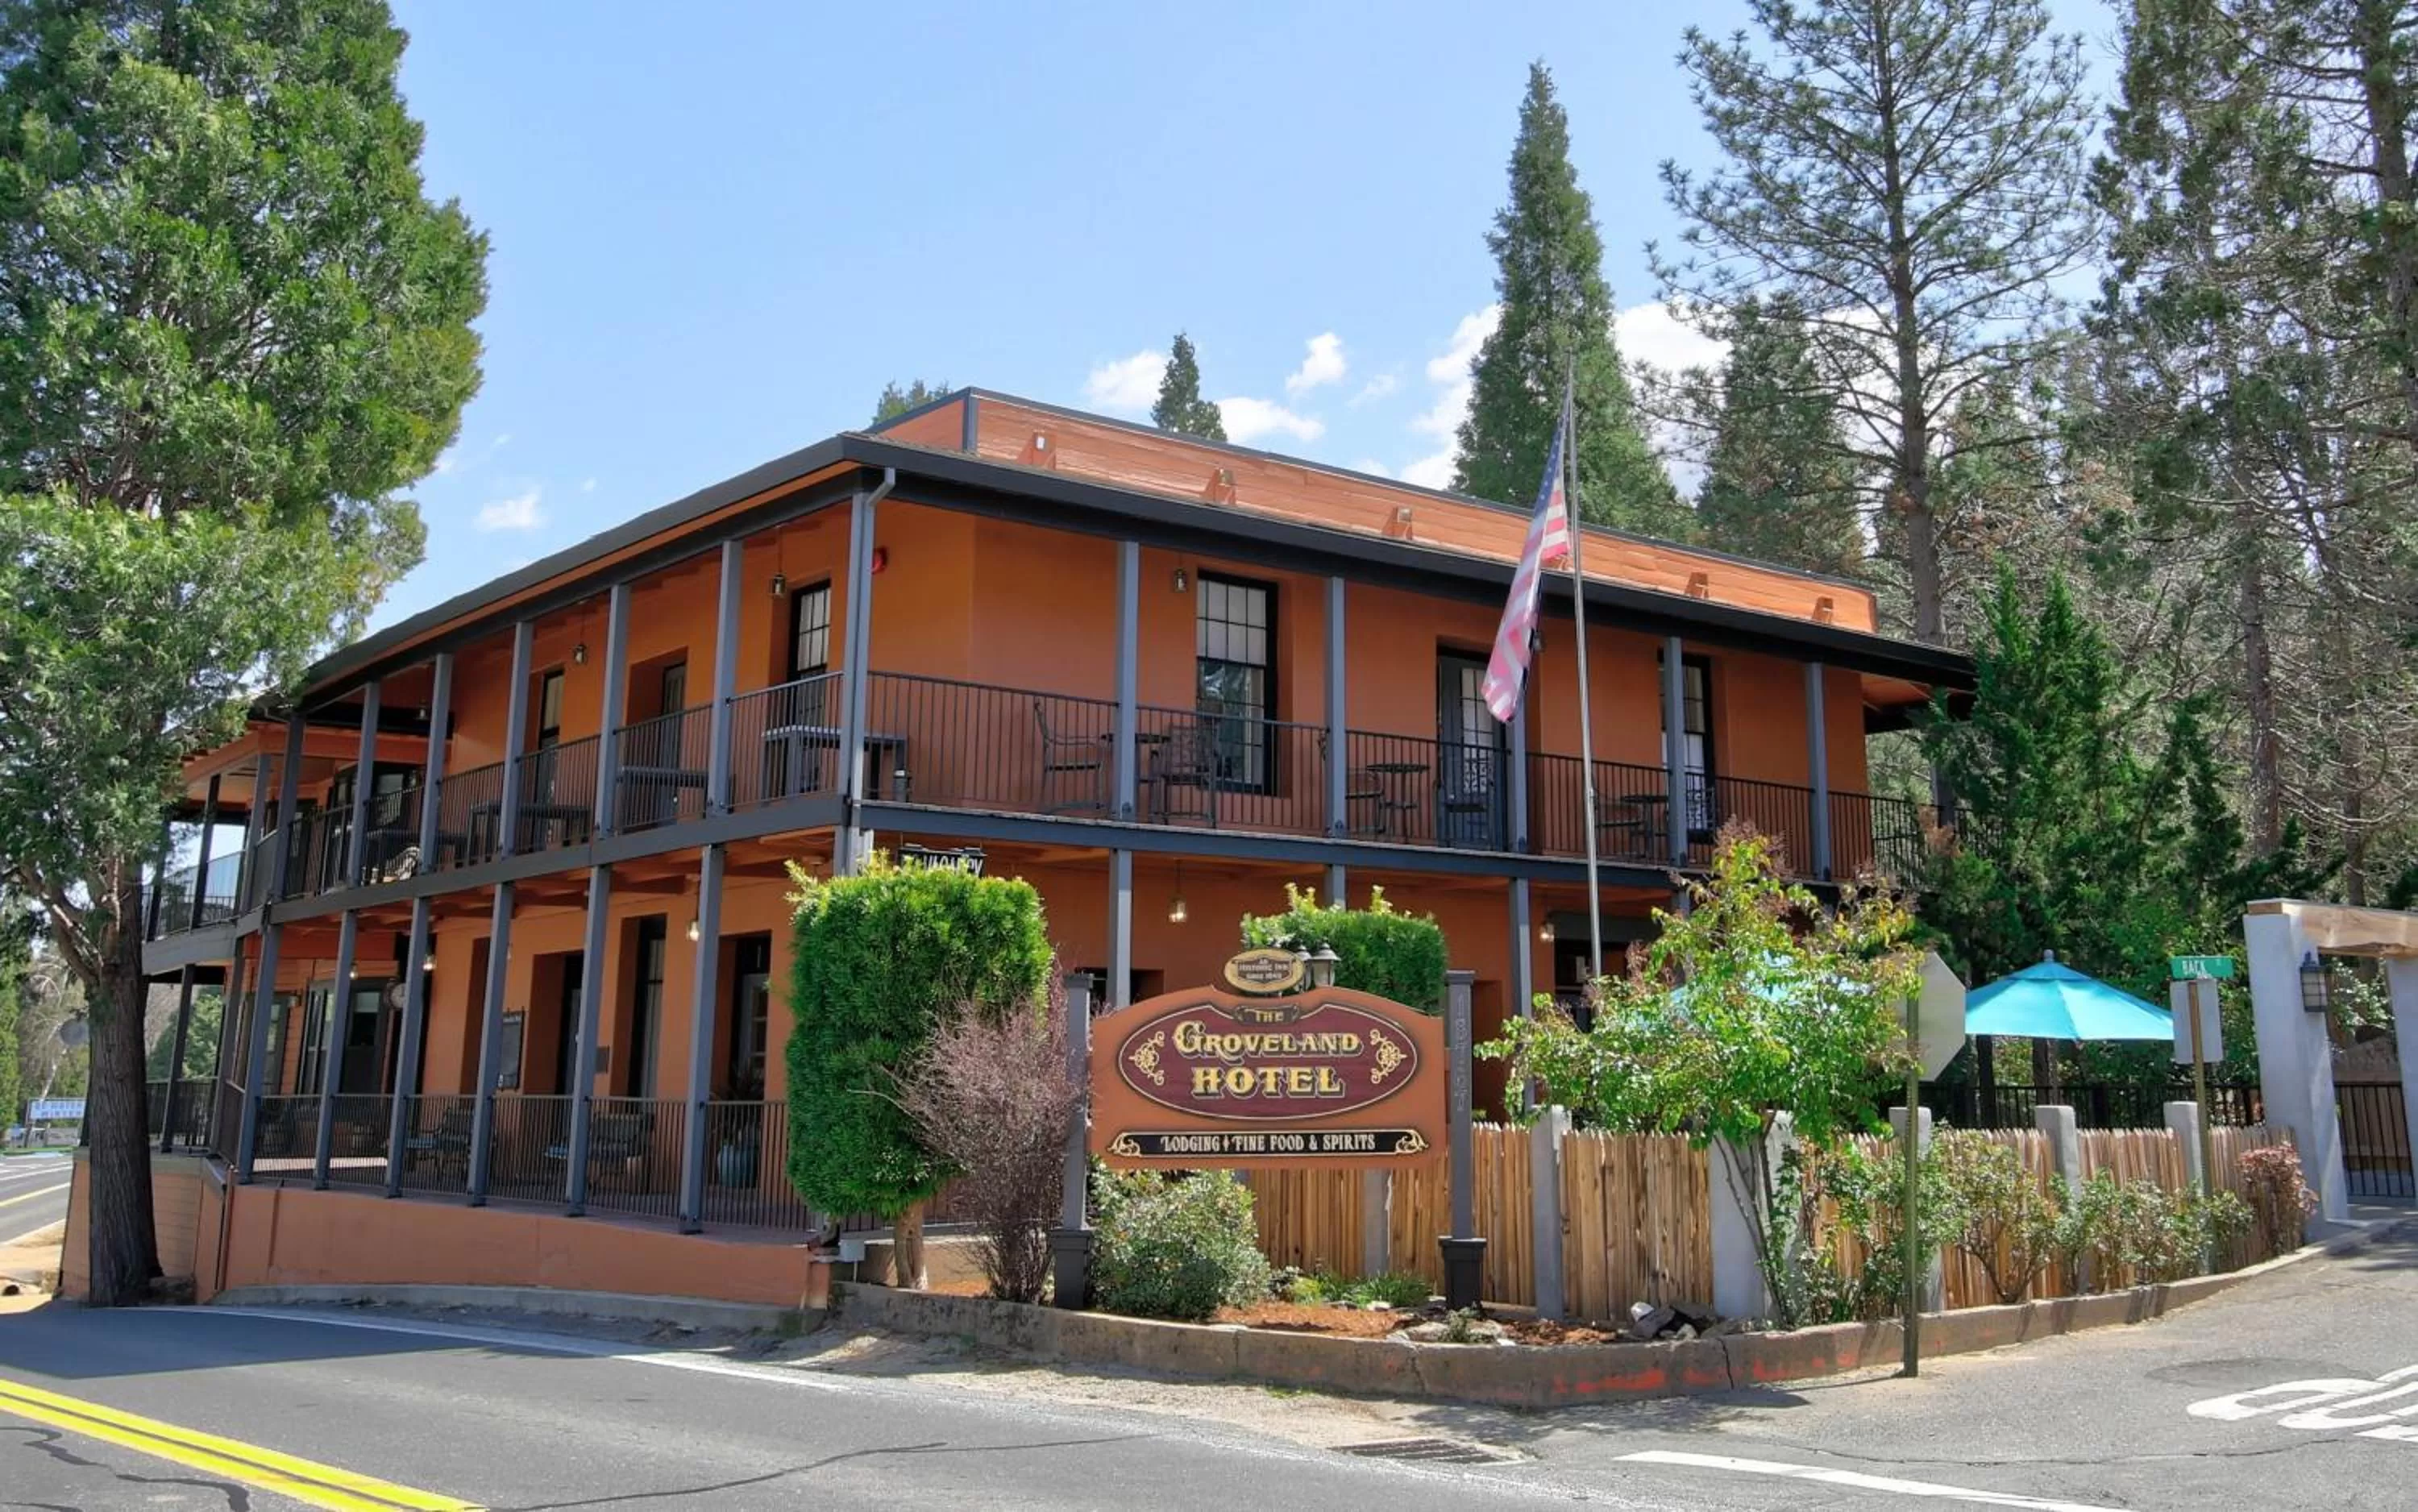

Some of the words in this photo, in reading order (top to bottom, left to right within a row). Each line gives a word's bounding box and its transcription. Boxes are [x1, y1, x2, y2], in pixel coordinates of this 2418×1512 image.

[1254, 1009, 1285, 1024] THE
[1173, 1020, 1364, 1065] GROVELAND
[1191, 1065, 1346, 1099] HOTEL
[1160, 1135, 1220, 1153] LODGING
[1231, 1135, 1265, 1152] FINE
[1269, 1135, 1304, 1152] FOOD
[1308, 1135, 1319, 1151] &
[1322, 1133, 1377, 1151] SPIRITS
